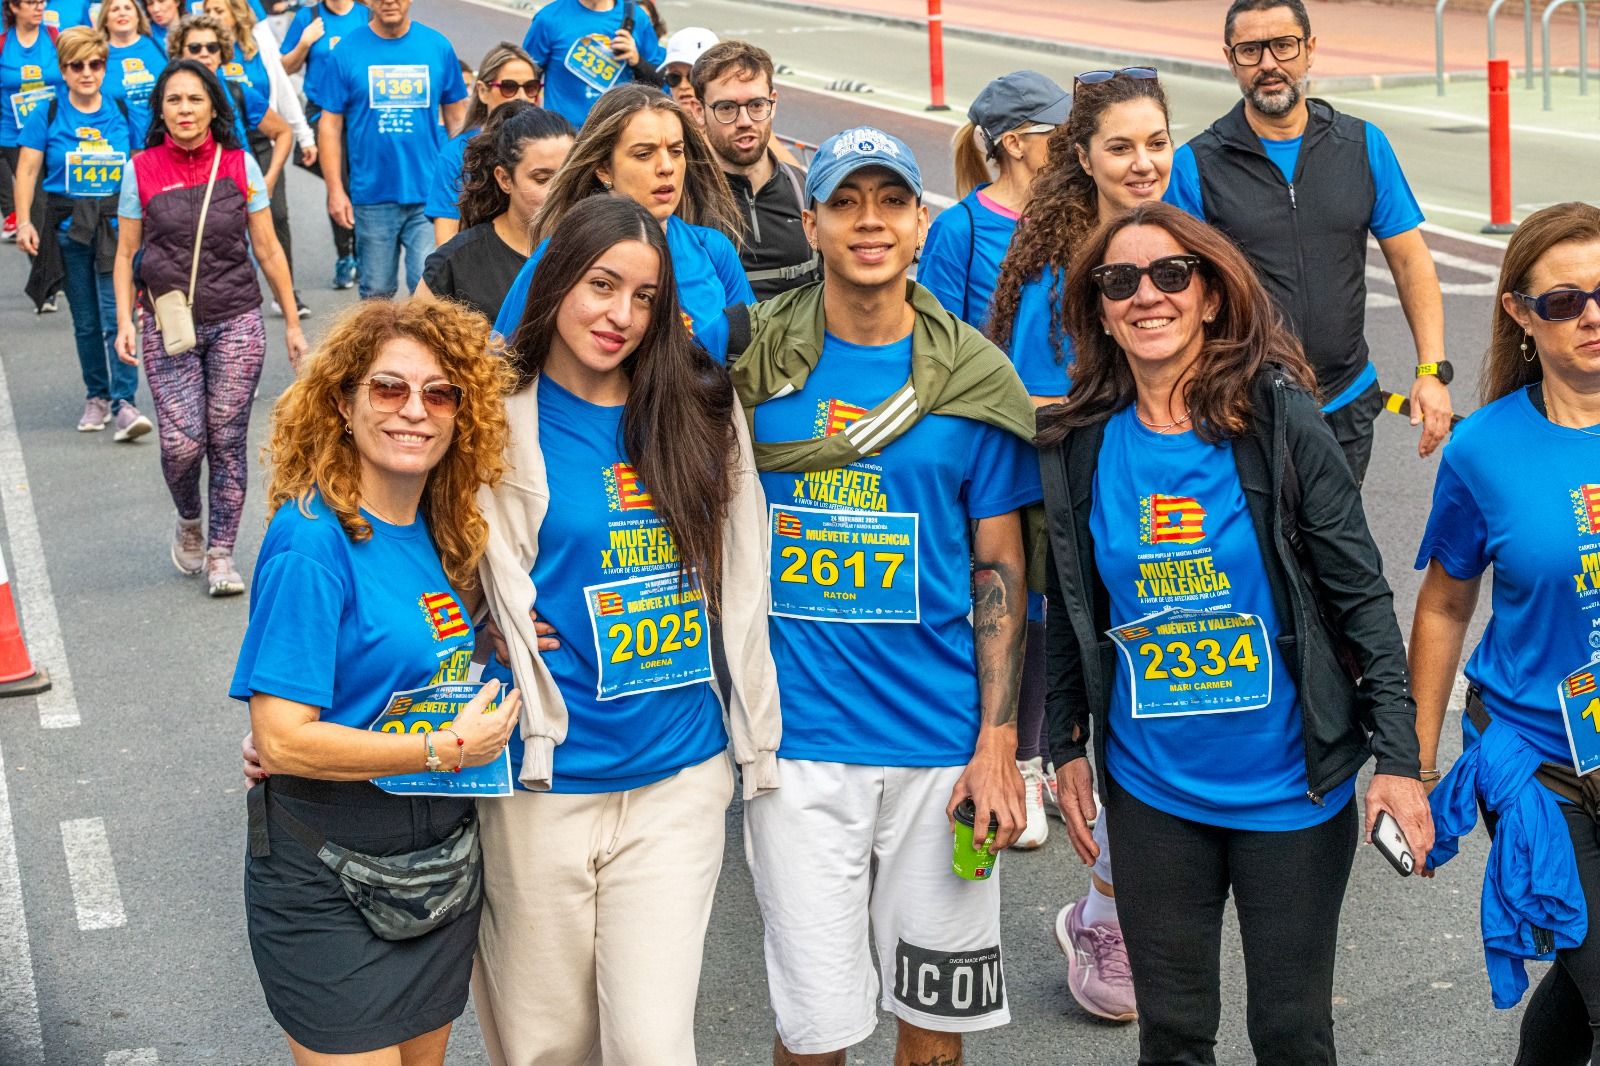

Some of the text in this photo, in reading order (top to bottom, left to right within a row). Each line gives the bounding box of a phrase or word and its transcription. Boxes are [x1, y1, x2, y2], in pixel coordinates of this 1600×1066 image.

[573, 46, 616, 81] 2335
[375, 79, 423, 95] 1361
[73, 166, 121, 182] 1414
[793, 480, 887, 512] X VALENCIA
[805, 528, 910, 546] MUÉVETE X VALENCIA
[600, 549, 613, 569] X
[780, 546, 905, 588] 2617
[1139, 556, 1216, 580] MUÉVETE
[1134, 571, 1231, 598] X VALENCIA
[1573, 573, 1587, 592] X
[663, 595, 670, 607] X
[608, 608, 703, 664] 2025
[1155, 621, 1197, 635] MUÉVETE
[1199, 619, 1207, 632] X
[640, 657, 673, 670] LORENA
[1139, 633, 1260, 681] 2334
[1169, 680, 1233, 692] MARI CARMEN
[409, 700, 448, 713] MUÉVETE
[448, 703, 456, 713] X
[901, 955, 998, 1010] ICON
